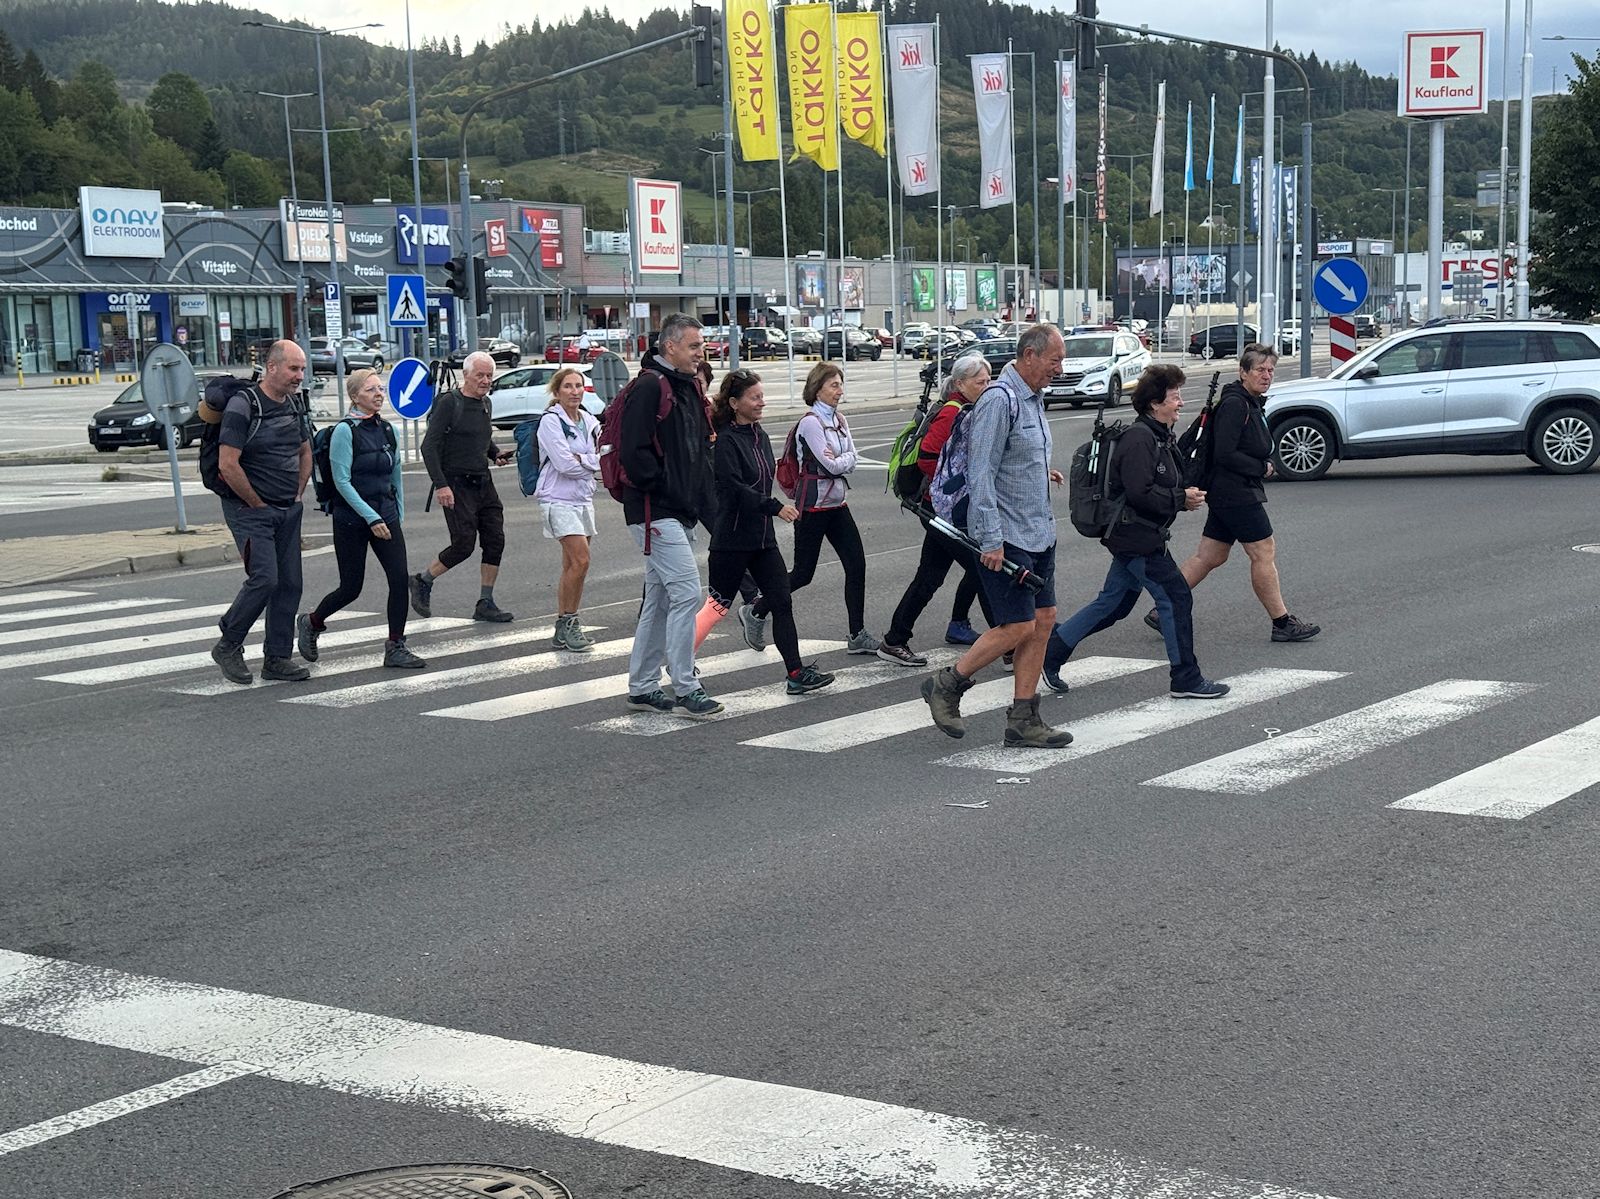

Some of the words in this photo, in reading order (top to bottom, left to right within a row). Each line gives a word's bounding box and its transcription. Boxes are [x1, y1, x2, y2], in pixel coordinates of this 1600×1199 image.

[1415, 85, 1474, 98] Kaufland
[93, 226, 161, 238] ELEKTRODOM
[349, 231, 384, 246] Vstúpte
[644, 242, 675, 255] Kaufland
[202, 260, 237, 276] Vitajte
